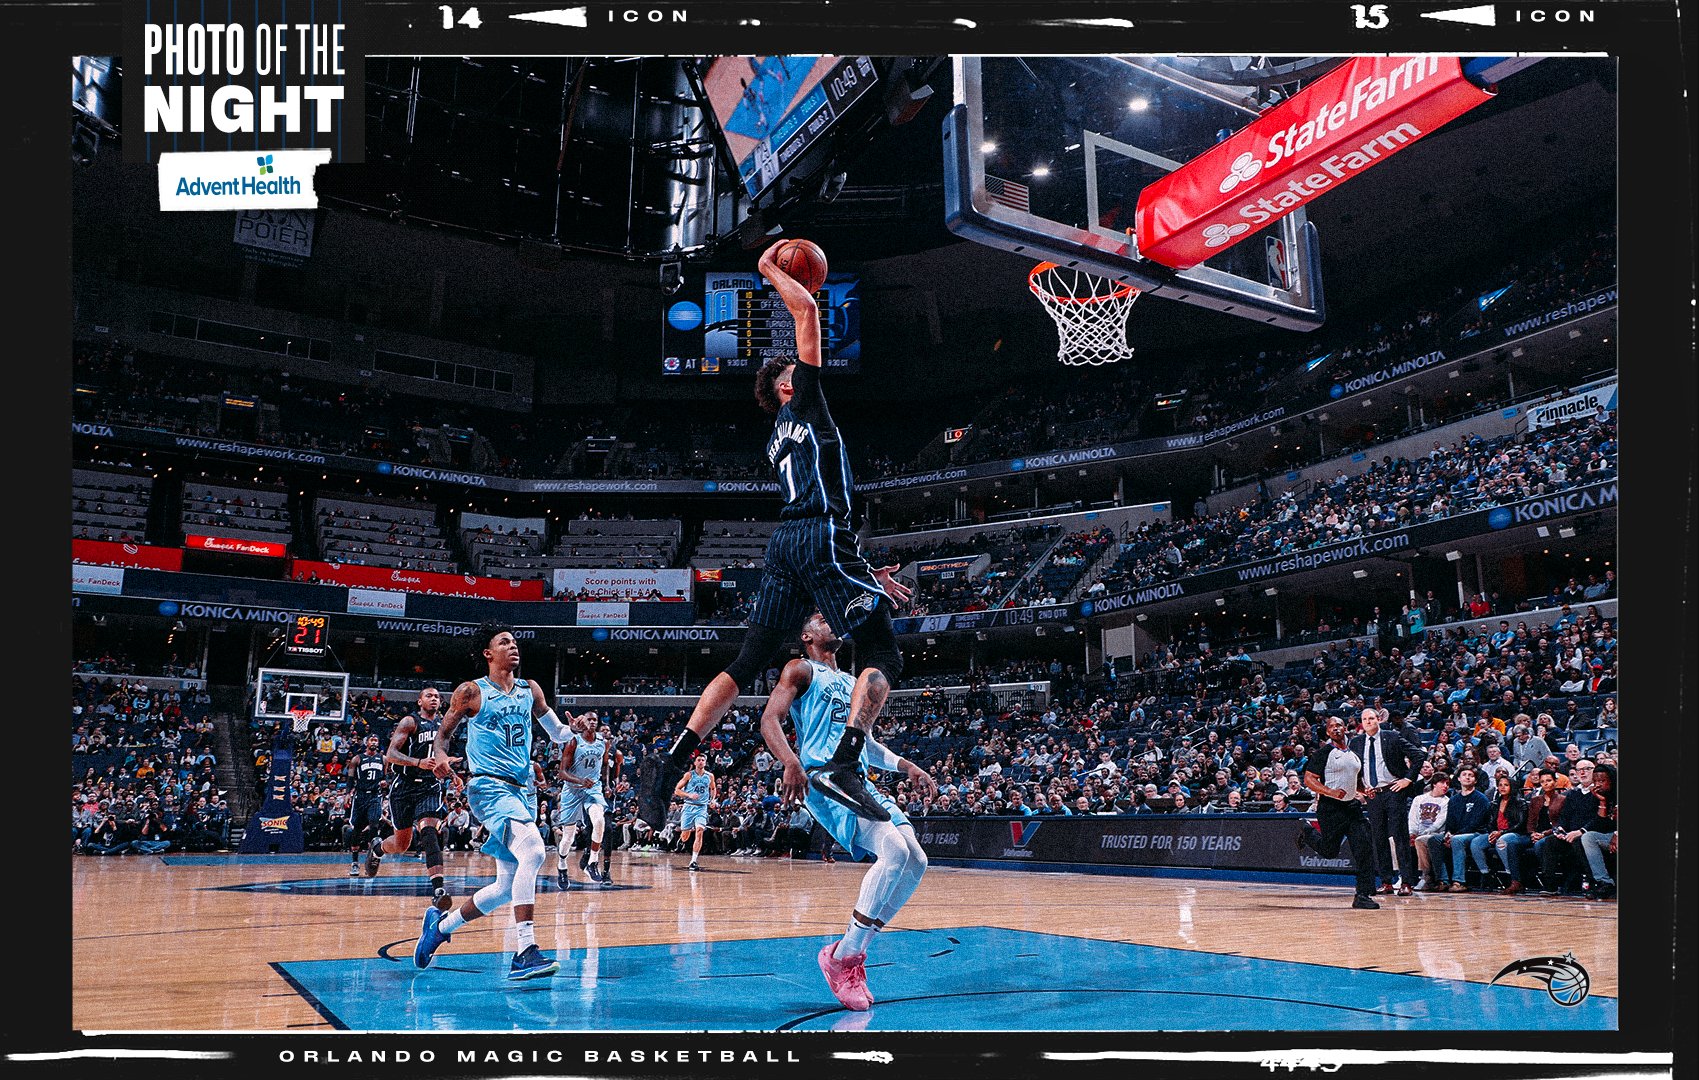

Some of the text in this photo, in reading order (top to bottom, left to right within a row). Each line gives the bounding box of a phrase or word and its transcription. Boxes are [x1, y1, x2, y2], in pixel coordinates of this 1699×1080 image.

[830, 65, 858, 101] 10:49
[685, 359, 697, 369] AT
[1345, 350, 1446, 393] KONICA MINOLTA
[1166, 405, 1285, 448] www.reshapework.com
[175, 436, 325, 465] www.reshapework.com
[393, 465, 487, 487] KONICA MINOLTA
[779, 452, 796, 503] 7
[854, 447, 1116, 492] www.reshapework.com KONICA MINOLTA
[533, 479, 657, 492] www.reshapework.com
[718, 482, 759, 492] KONICA
[1515, 491, 1596, 523] KONICA
[236, 544, 270, 554] FanDeck
[1094, 533, 1409, 614] KONICA MINOLTA www.reshapework.com
[88, 577, 121, 587] FanDeck
[585, 577, 657, 588] Score points with
[181, 603, 243, 620] KONICA
[376, 601, 404, 610] FanDeck
[298, 616, 325, 628] 10:49
[1005, 609, 1034, 625] 10:49
[294, 627, 321, 644] 21
[611, 629, 719, 641] KONICA MINOLTA
[503, 723, 525, 748] 12
[584, 758, 596, 769] 14
[367, 771, 376, 780] 31
[935, 834, 959, 845] YEARS
[1101, 834, 1241, 851] TRUSTED FOR 150 YEARS
